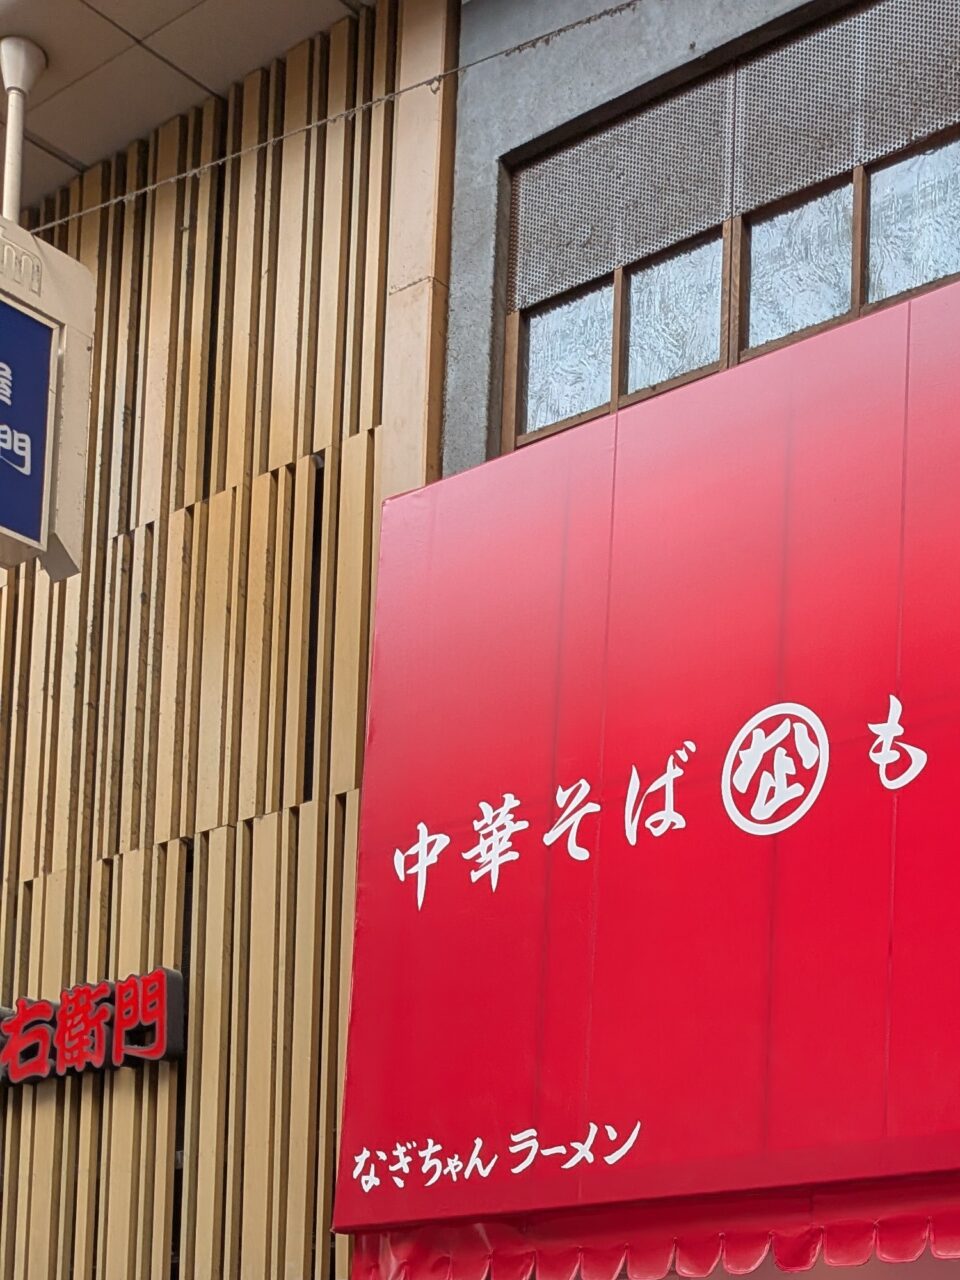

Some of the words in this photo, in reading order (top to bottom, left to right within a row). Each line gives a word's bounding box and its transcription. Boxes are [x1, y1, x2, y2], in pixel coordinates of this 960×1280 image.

[393, 741, 697, 910] 中華そば
[2, 968, 168, 1084] 右衛門
[352, 1136, 498, 1194] なぎちゃん
[508, 1120, 642, 1172] ラーメン
